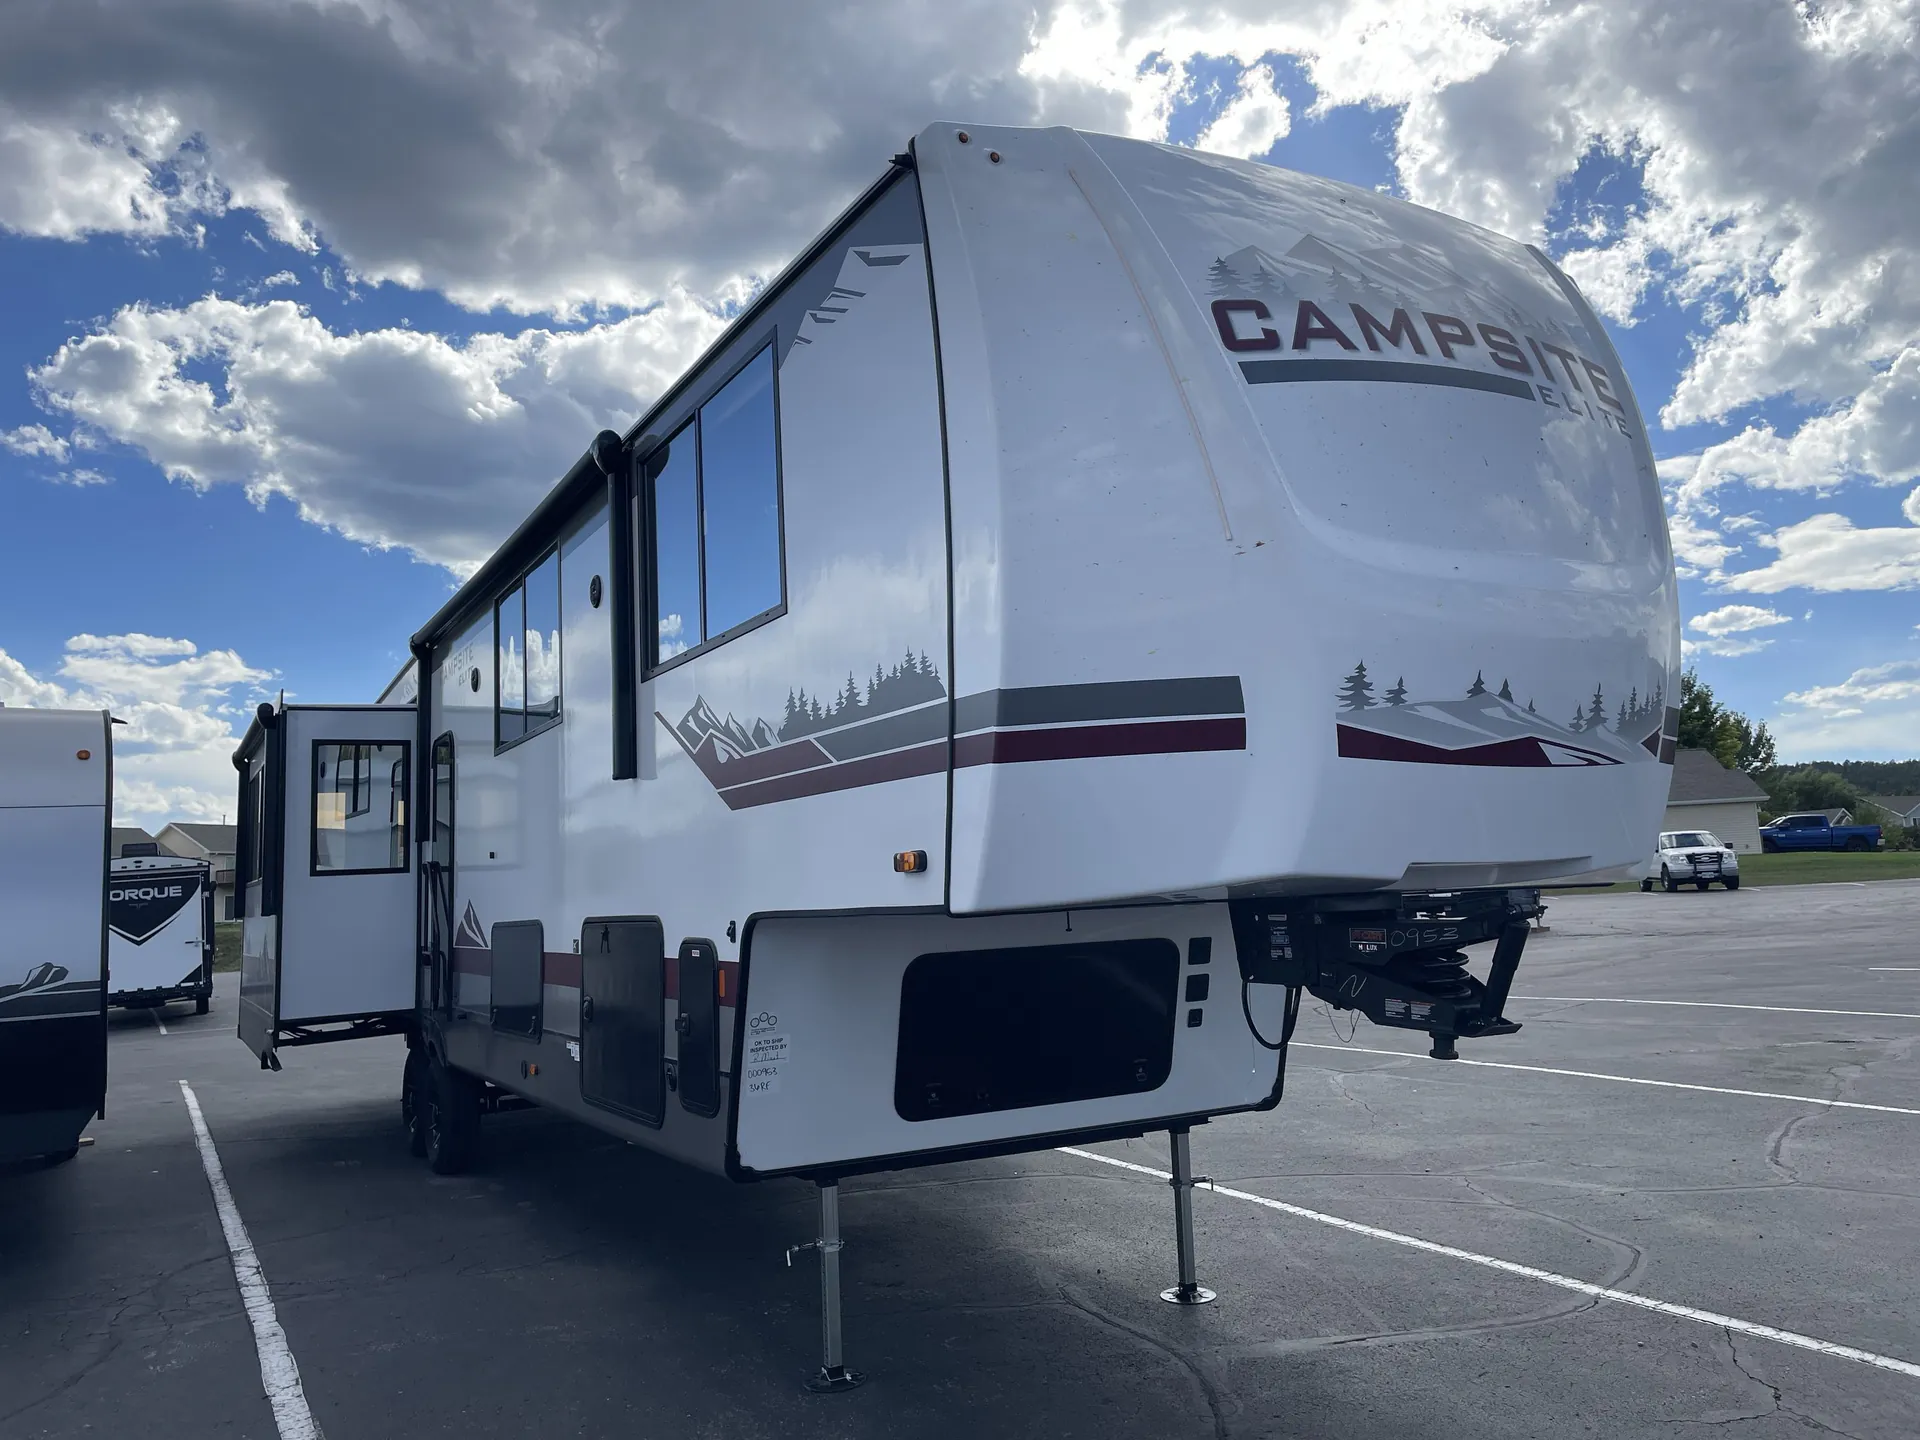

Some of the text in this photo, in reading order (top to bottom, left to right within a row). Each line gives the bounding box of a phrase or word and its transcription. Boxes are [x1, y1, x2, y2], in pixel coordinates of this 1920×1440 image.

[1211, 299, 1625, 416] CAMPSITE
[1535, 384, 1633, 440] ELITE
[109, 886, 182, 901] ORQUE
[750, 1045, 779, 1053] INSPECTED
